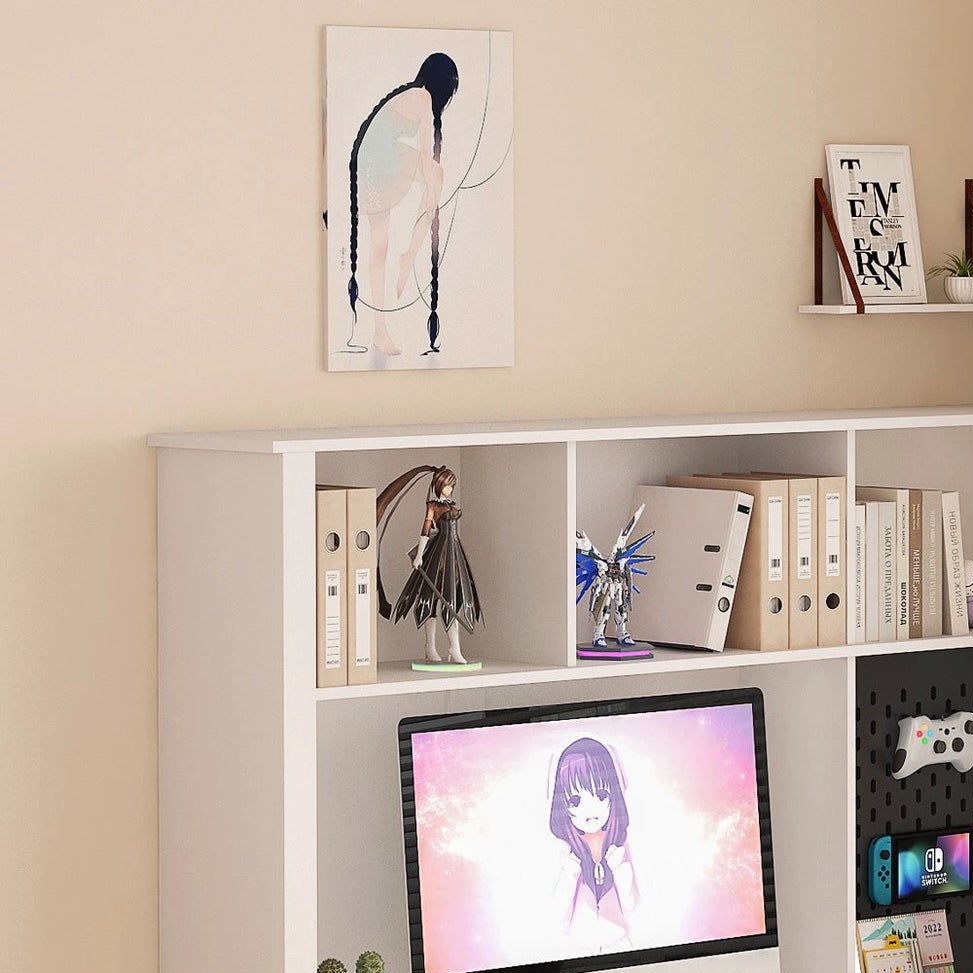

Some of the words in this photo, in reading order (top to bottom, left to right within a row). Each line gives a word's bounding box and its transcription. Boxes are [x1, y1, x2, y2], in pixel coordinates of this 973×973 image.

[884, 526, 892, 558] ЗАБОТА
[950, 511, 959, 546] НОВЫЙ
[884, 560, 892, 568] О
[952, 548, 960, 580] ОБРАЗ
[884, 570, 892, 624] ПРЕДАННЫХ
[954, 582, 964, 618] ЖИЗНИ
[923, 922, 942, 934] 2022
